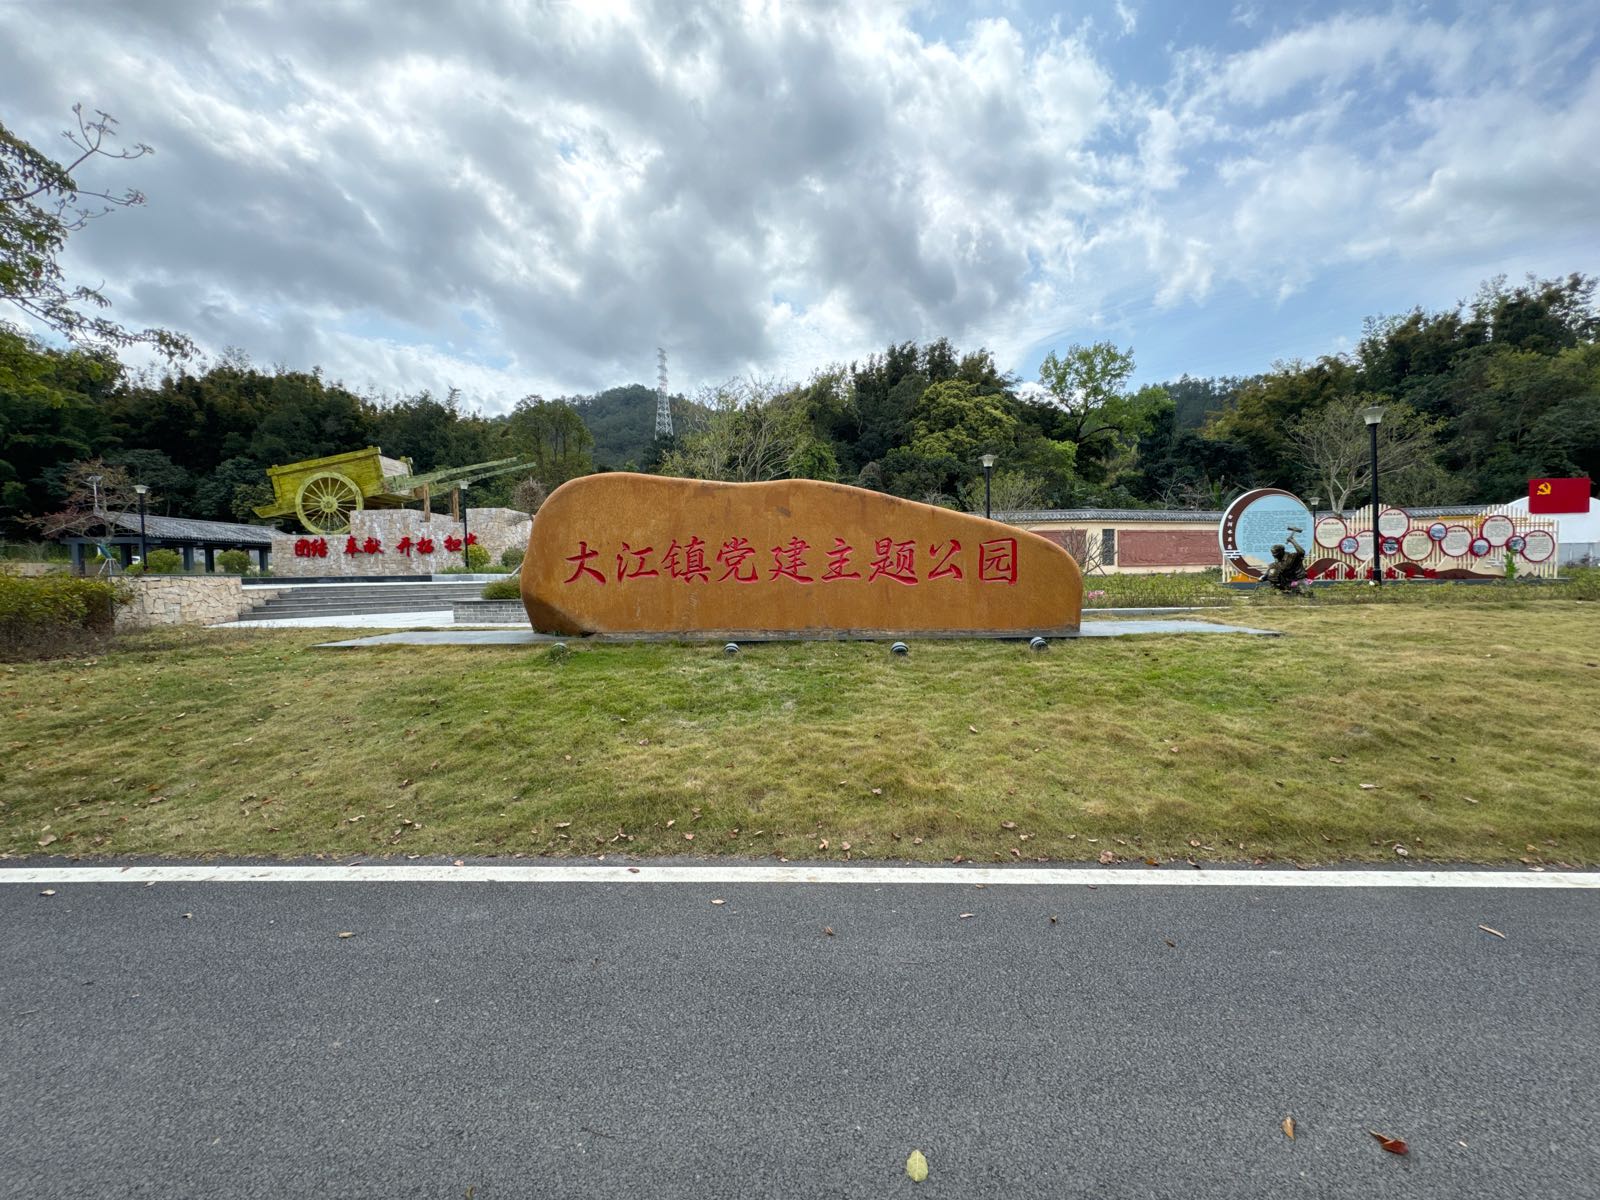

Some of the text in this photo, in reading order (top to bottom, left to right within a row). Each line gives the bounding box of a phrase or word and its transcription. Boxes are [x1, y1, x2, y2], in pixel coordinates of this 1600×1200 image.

[294, 537, 329, 558] 团结
[343, 535, 385, 559] 奉献
[396, 536, 435, 557] 开拓
[564, 536, 1018, 586] 大江镇党建主题公园
